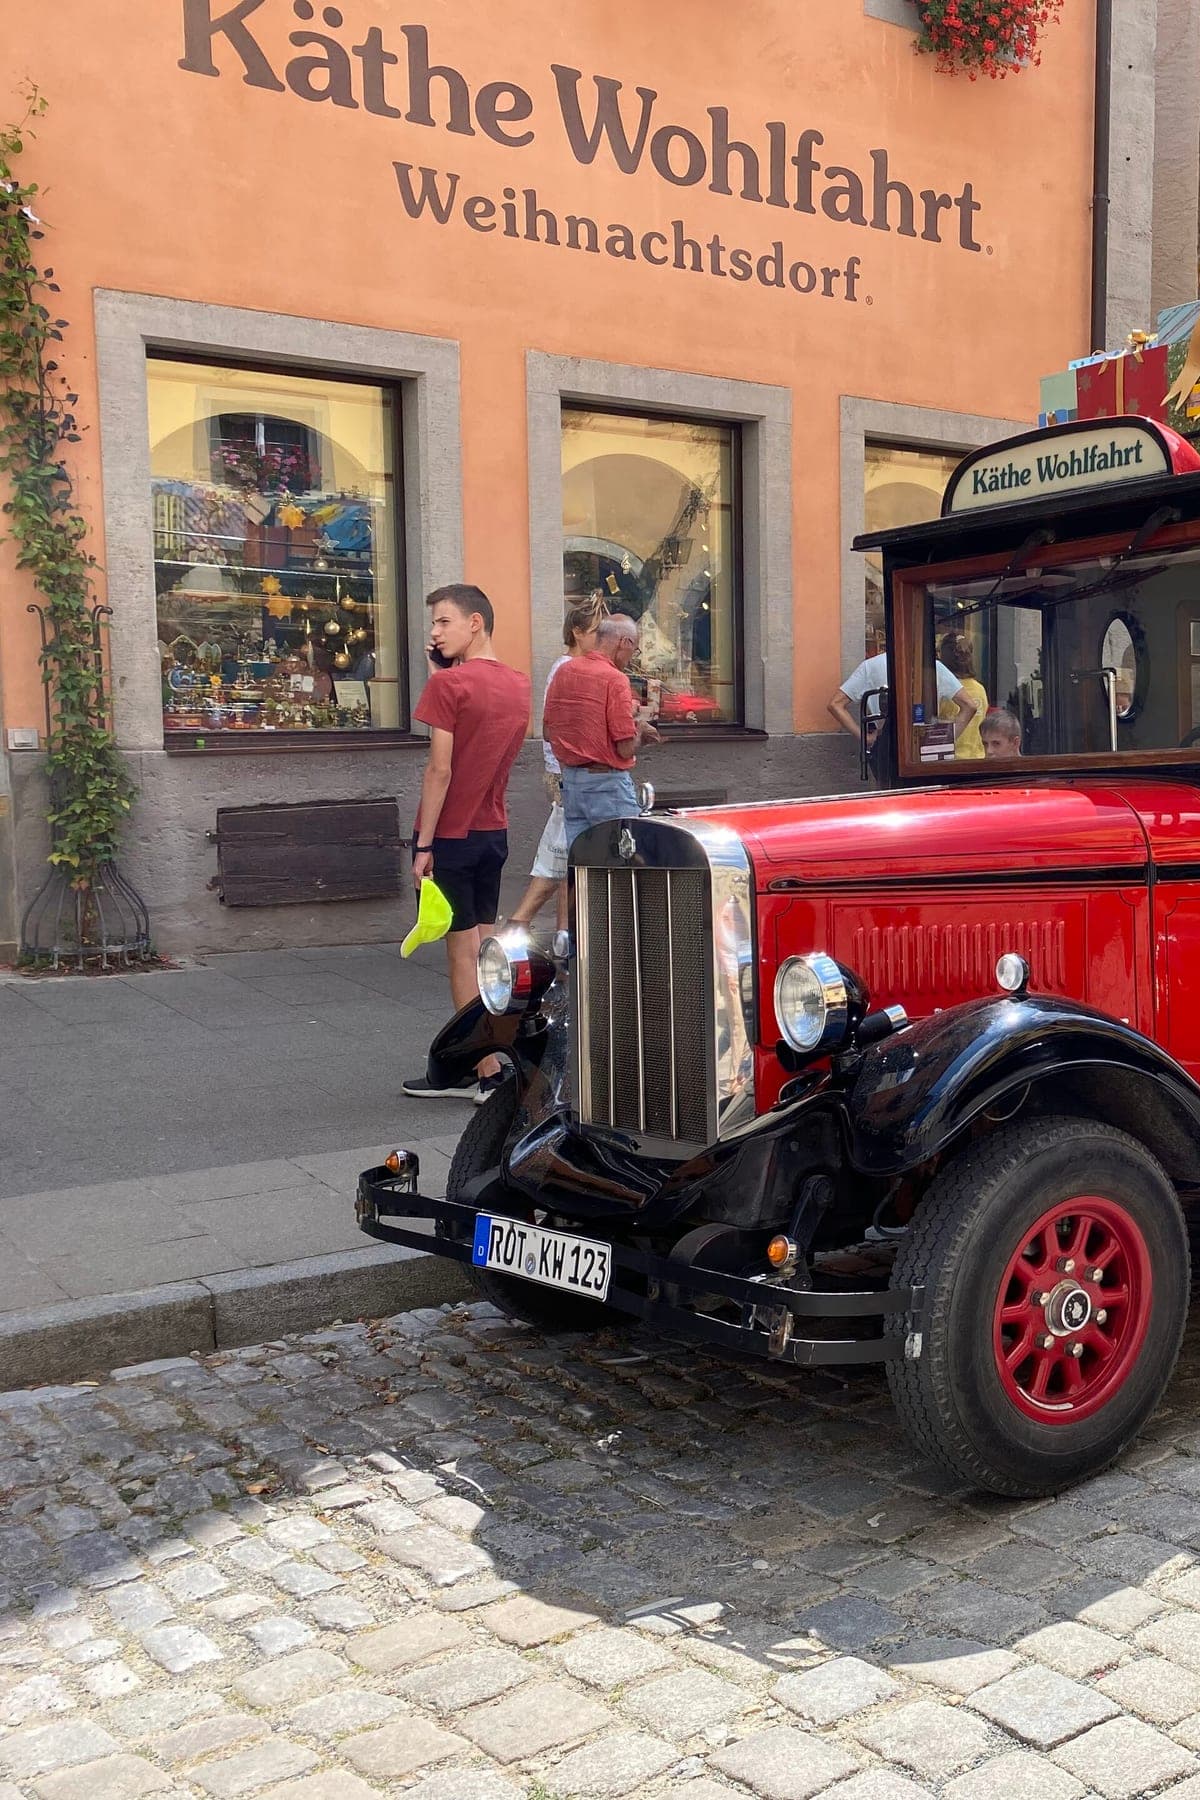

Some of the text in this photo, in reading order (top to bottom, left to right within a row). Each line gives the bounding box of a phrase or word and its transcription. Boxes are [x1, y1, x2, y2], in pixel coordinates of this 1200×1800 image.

[178, 0, 981, 252] Käthe Wohlfahrt
[392, 161, 861, 301] Weihnachtsdorf
[973, 439, 1143, 495] Käthe Wohlfahrt
[477, 1246, 484, 1257] D
[488, 1224, 607, 1292] ROT KW 123
